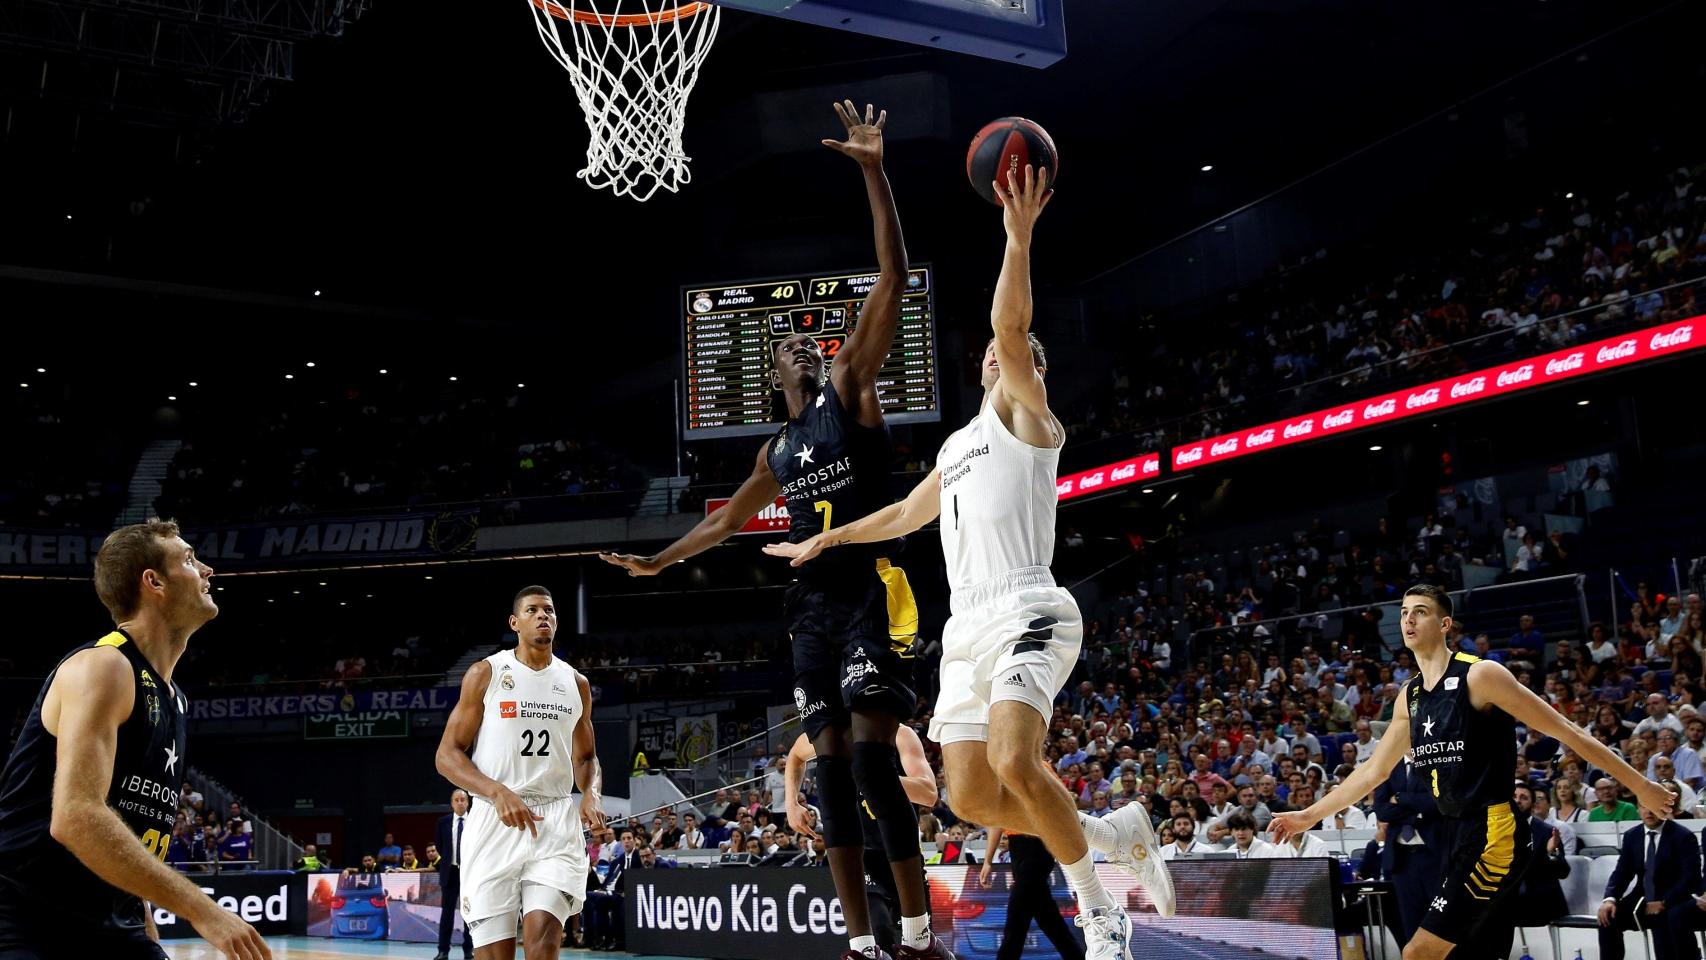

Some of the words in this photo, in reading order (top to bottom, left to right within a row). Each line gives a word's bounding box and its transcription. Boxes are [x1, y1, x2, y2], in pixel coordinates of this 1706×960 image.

[717, 296, 755, 306] MADRID
[852, 285, 874, 294] TEN
[723, 288, 748, 297] REAL
[771, 285, 794, 299] 40
[815, 281, 839, 296] 37
[847, 275, 880, 285] IBERO
[802, 314, 813, 327] 3
[814, 500, 833, 533] 7
[953, 494, 959, 530] 1
[259, 518, 426, 557] MADRID
[370, 689, 449, 711] REAL
[520, 700, 573, 715] Universidad
[520, 709, 559, 720] Europea
[334, 723, 376, 738] EXIT
[520, 729, 550, 757] 22
[1410, 740, 1465, 758] BEROSTAR
[118, 799, 155, 817] HOTELS
[156, 810, 162, 820] &
[199, 884, 288, 922] eed
[636, 883, 723, 932] Nuevo
[730, 883, 779, 933] Kia
[787, 883, 848, 936] Cee
